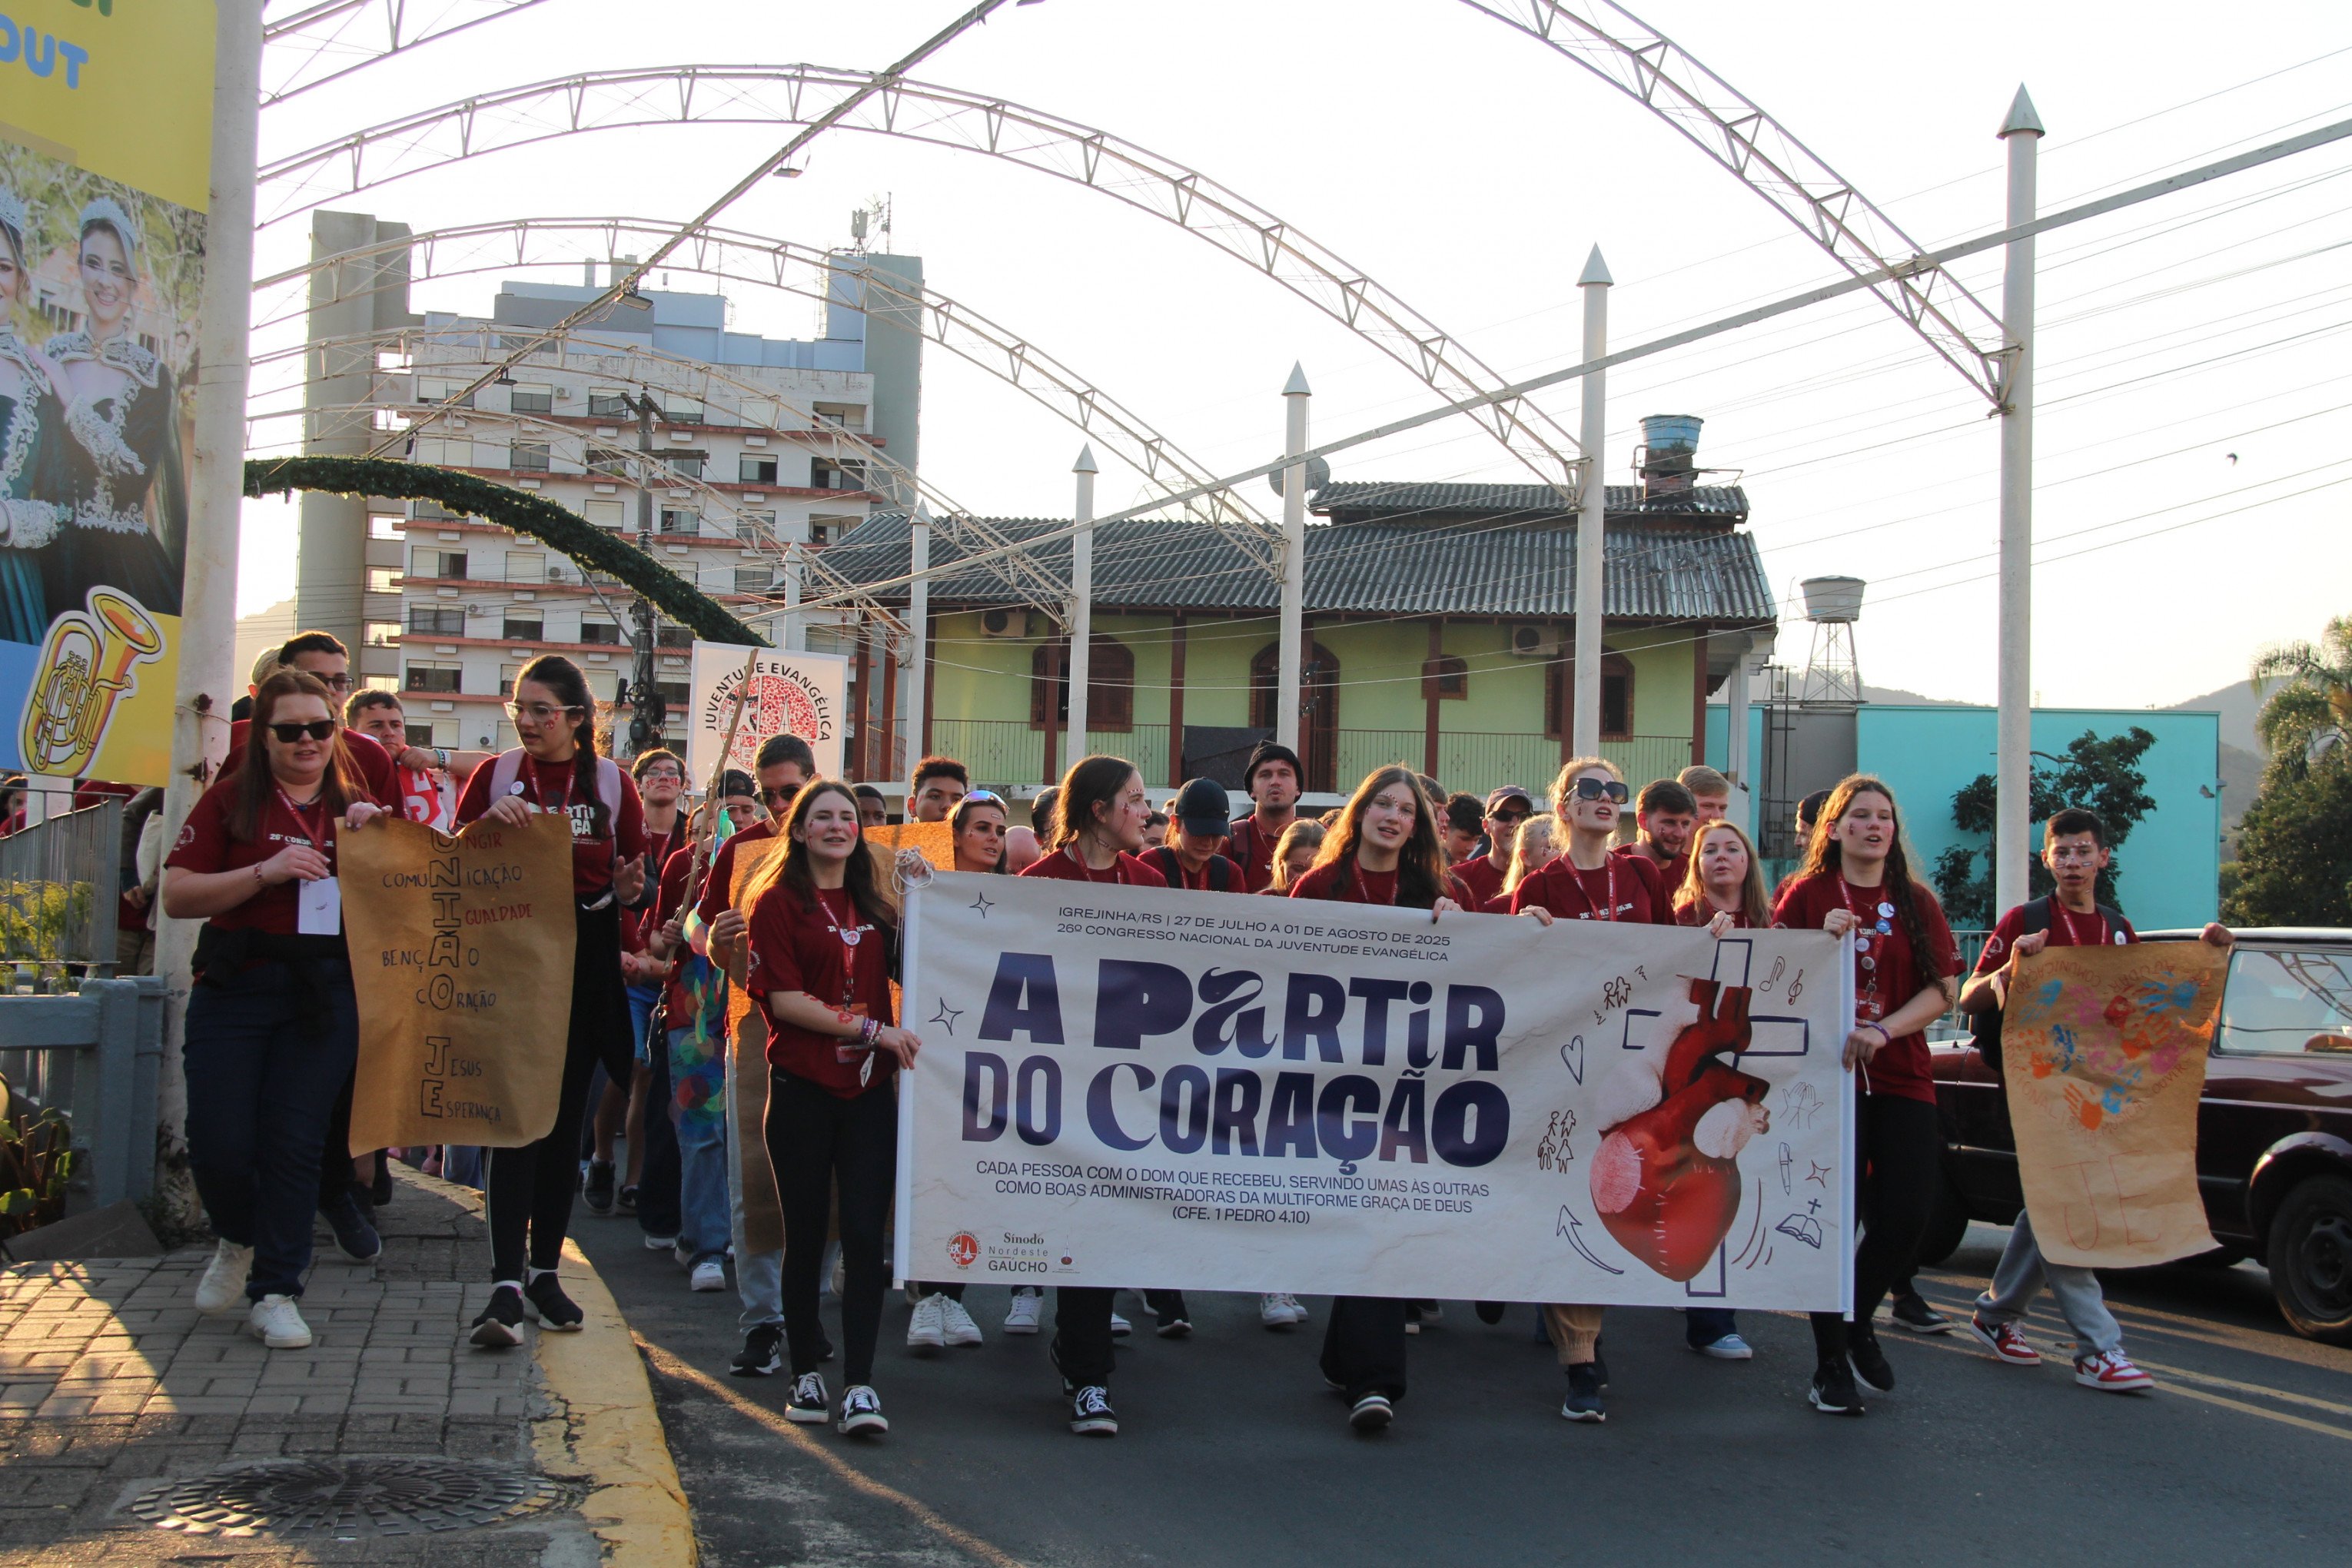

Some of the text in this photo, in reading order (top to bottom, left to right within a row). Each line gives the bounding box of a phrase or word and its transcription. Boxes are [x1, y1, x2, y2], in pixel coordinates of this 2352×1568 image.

[771, 663, 832, 741] EVANGÉLICA
[1058, 907, 1162, 923] IGREJINHA/RS
[1174, 915, 1191, 926] 27
[1194, 918, 1214, 928] DE
[1218, 919, 1267, 932] JULHO
[1270, 923, 1281, 933] A
[1284, 925, 1299, 935] 01
[1304, 925, 1324, 936] DE
[1327, 928, 1387, 941] AGOSTO
[1391, 932, 1411, 943] DE
[1414, 934, 1450, 946] 2025
[1085, 925, 1176, 941] CONGRESSO
[1179, 932, 1250, 947] NACIONAL
[1254, 938, 1273, 948] DA
[1277, 940, 1359, 955] JUVENTUDE
[1362, 946, 1449, 962] EVANGÉLICA
[977, 951, 1065, 1045] A
[962, 1051, 1510, 1176] DO CORAÇÃO
[976, 1161, 1490, 1197] CADA PESSOA COM O DOM QUE RECEBEU, SERVINDO UMAS ÀS OUTRAS
[995, 1180, 1473, 1213] COMO BOAS ADMINISTRADORAS DA MULTIFORME GRAÇA DE DEUS
[1172, 1205, 1310, 1224] (CFE. 1 PEDRO 4.10)
[2052, 1149, 2158, 1251] JE
[988, 1246, 1048, 1257] Nordeste
[1003, 1232, 1045, 1244] Sínodo
[988, 1257, 1048, 1273] GAÚCHO
